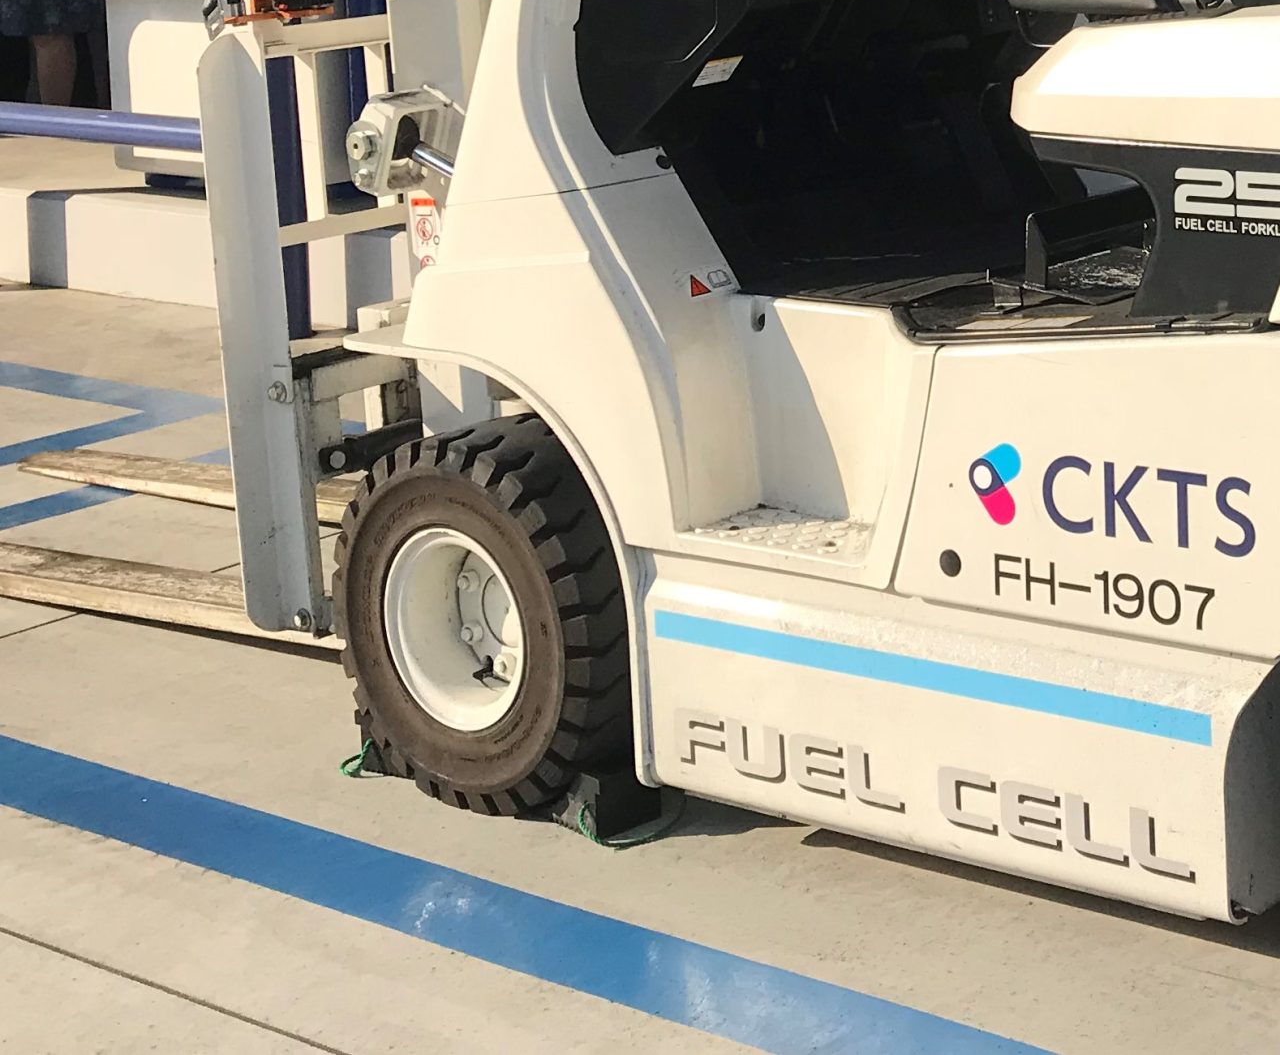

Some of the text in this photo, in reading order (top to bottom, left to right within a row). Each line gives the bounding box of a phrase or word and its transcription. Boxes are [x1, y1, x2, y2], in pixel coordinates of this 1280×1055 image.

[1174, 217, 1205, 231] FUEL
[1206, 219, 1238, 234] CELL
[1041, 454, 1258, 559] CKTS
[674, 706, 1196, 884] FUEL CELL
